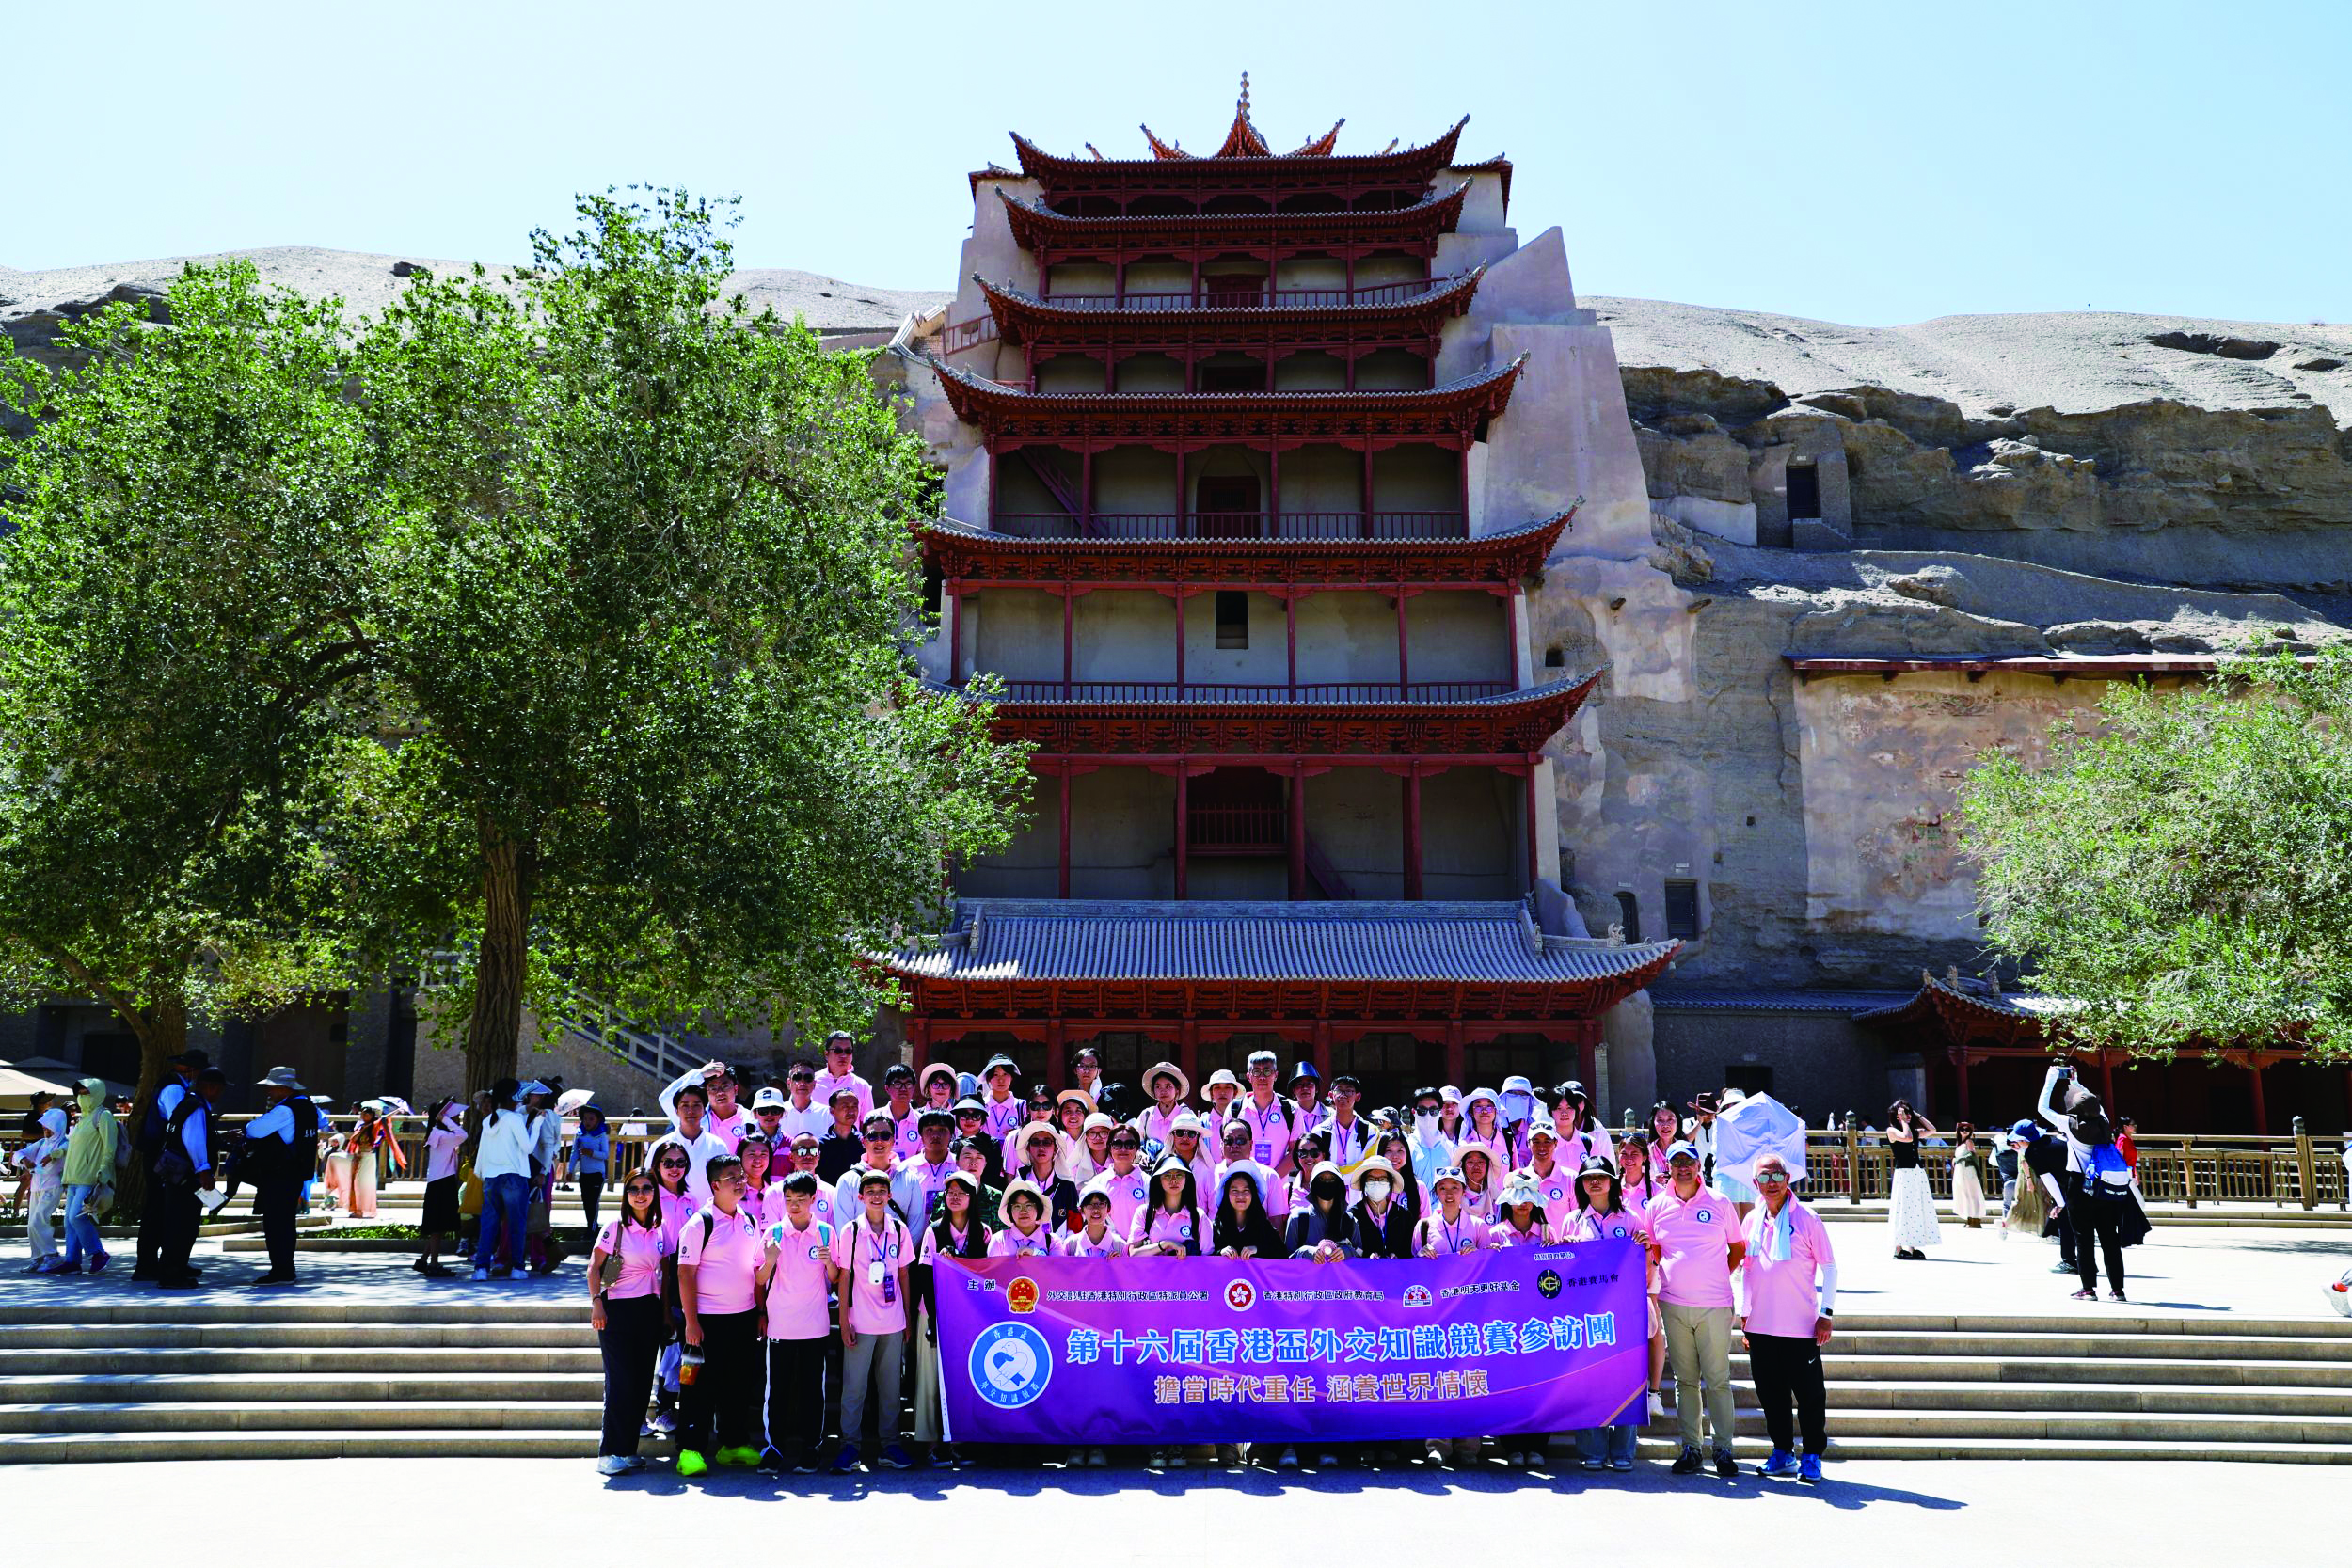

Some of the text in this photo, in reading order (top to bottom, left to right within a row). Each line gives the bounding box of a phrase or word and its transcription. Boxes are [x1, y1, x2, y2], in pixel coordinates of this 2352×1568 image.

[1440, 1280, 1520, 1298] 香港明天更好基金
[1567, 1273, 1618, 1288] 香港賽馬會
[1263, 1290, 1384, 1301] 香港特別行政區政府教育局
[1066, 1311, 1617, 1364] 第十六屆香港盃外交知識競賽參訪團
[1154, 1369, 1489, 1404] 擔當時代重任 涵養世界情懷
